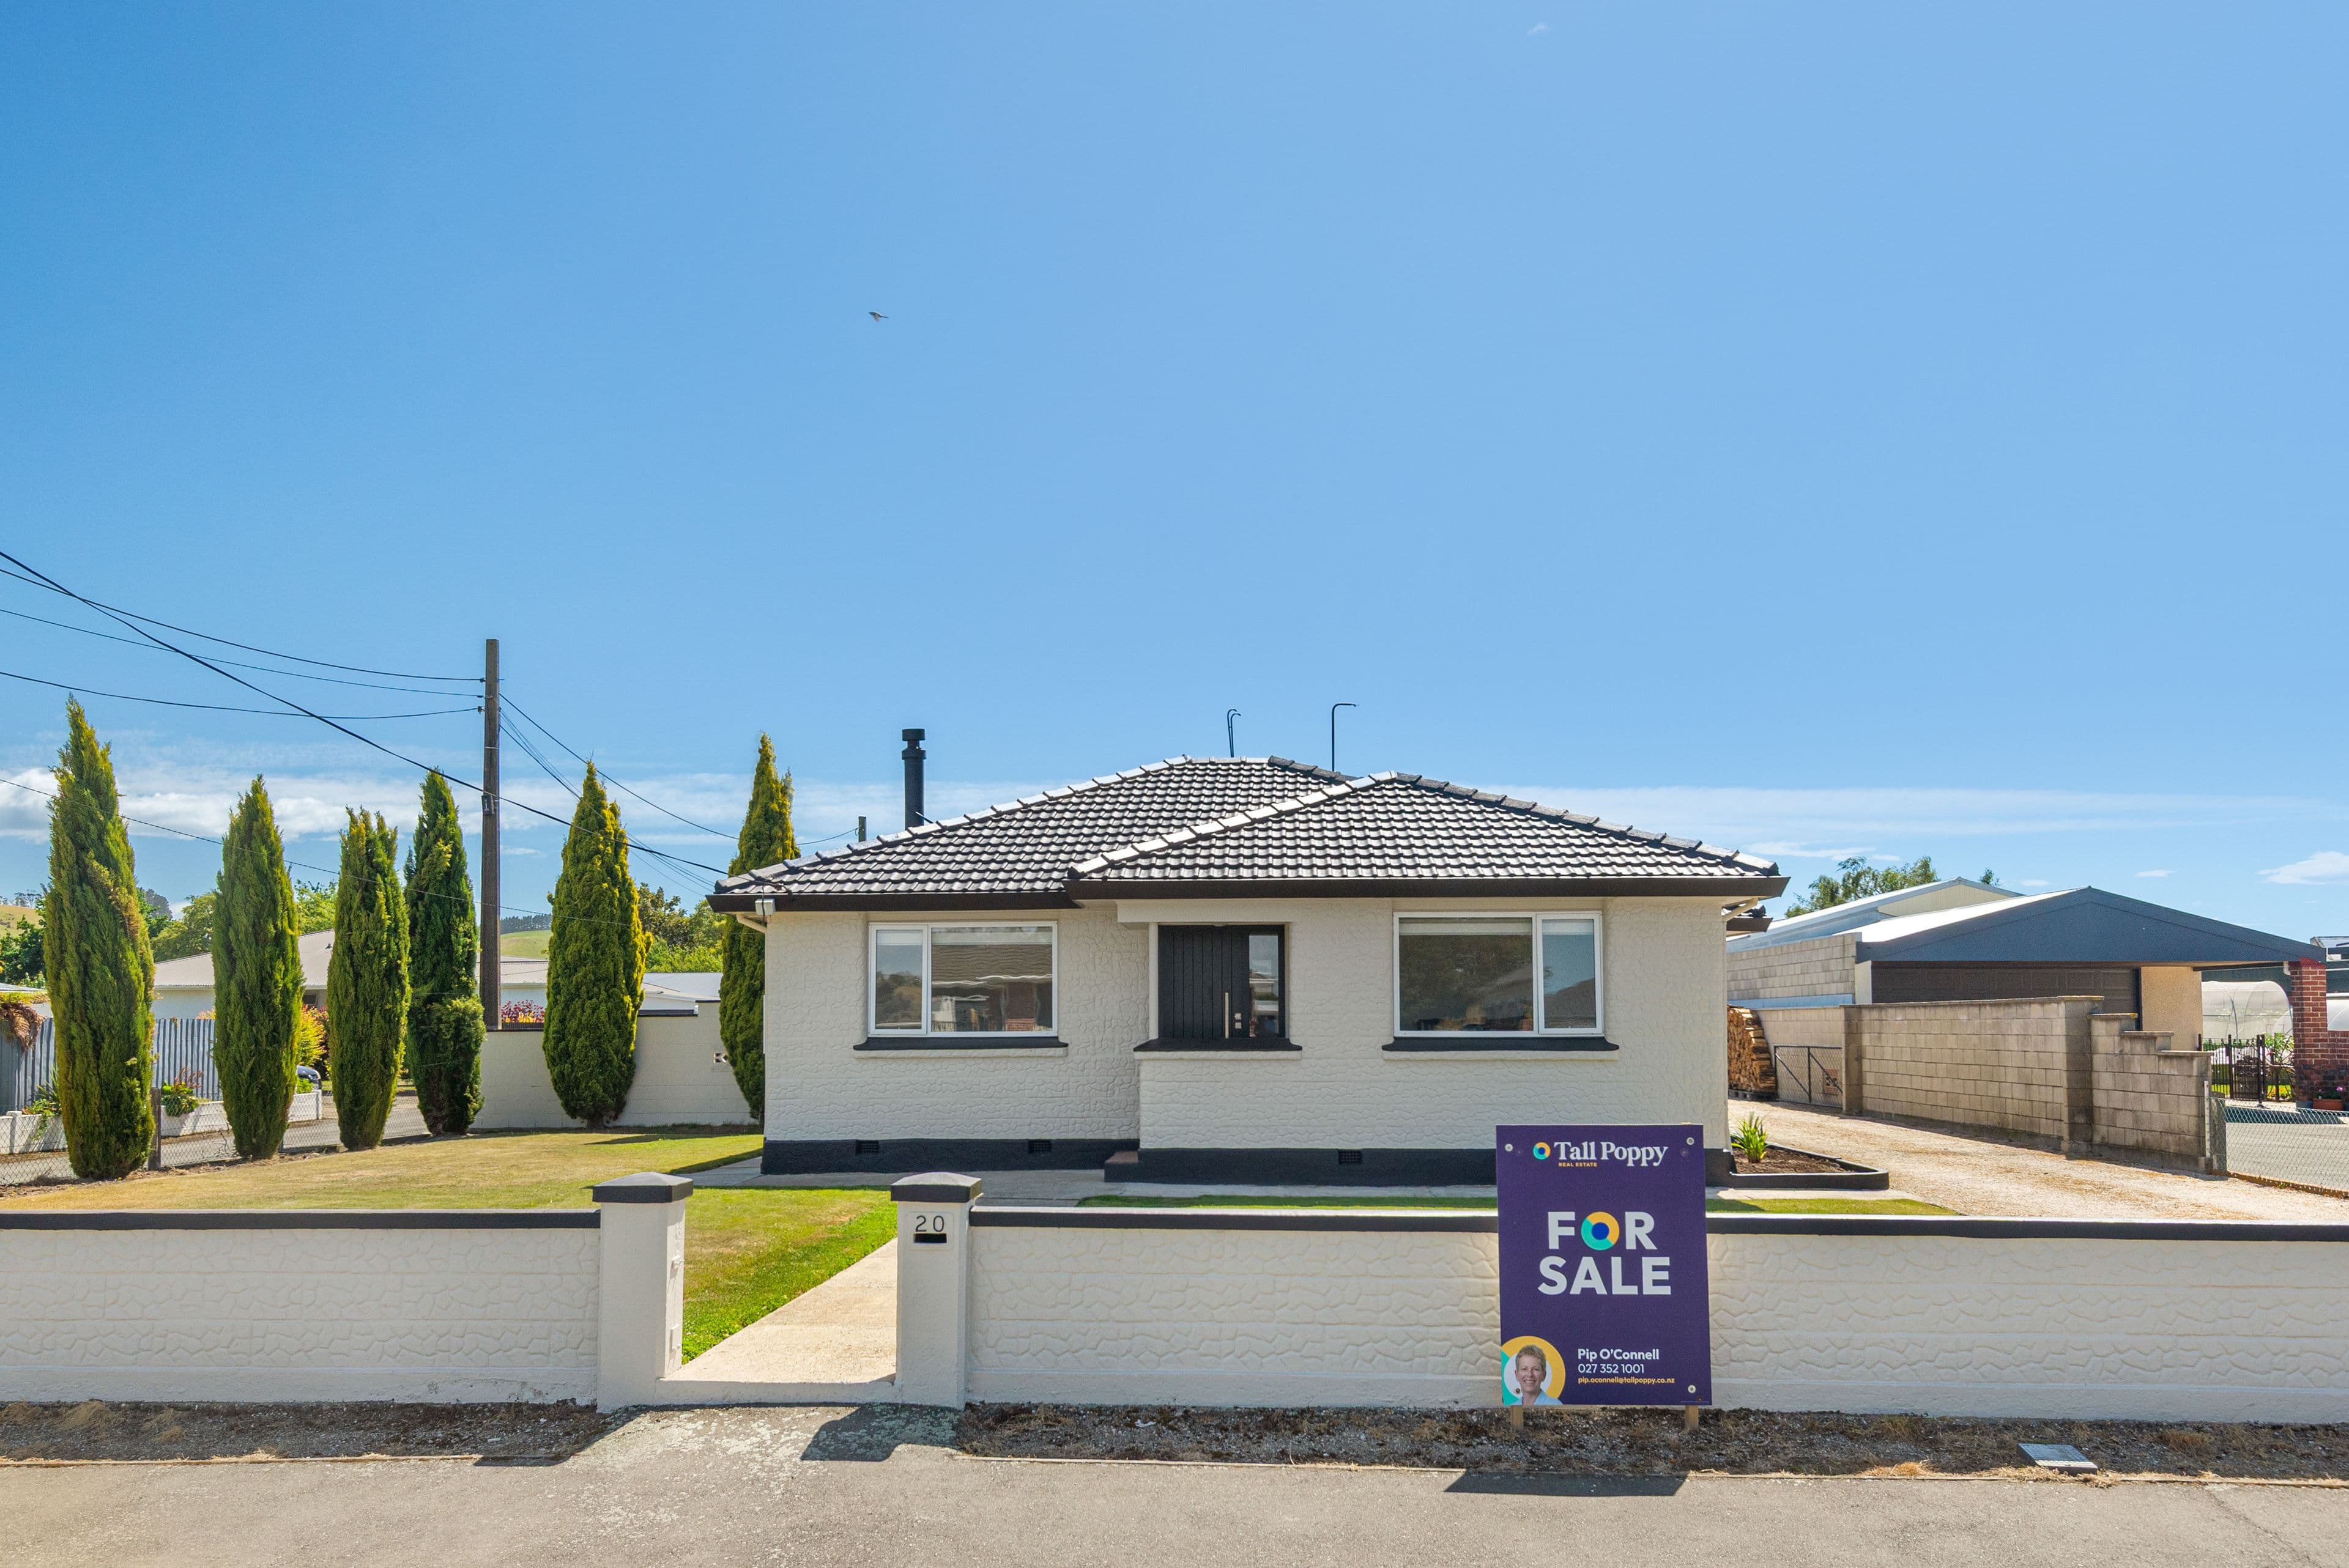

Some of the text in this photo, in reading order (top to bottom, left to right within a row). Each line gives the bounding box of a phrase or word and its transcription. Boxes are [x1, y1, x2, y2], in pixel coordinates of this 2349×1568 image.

[1554, 1141, 1668, 1166] Tall Poppy
[915, 1215, 944, 1232] 20
[1548, 1211, 1657, 1251] FOR
[1537, 1256, 1671, 1295] SALE
[1578, 1348, 1659, 1362] Pip O'Connell
[1578, 1364, 1644, 1373] 027 352 1001
[1578, 1376, 1675, 1385] pip.oconnell@tallpoppy.co.nz
